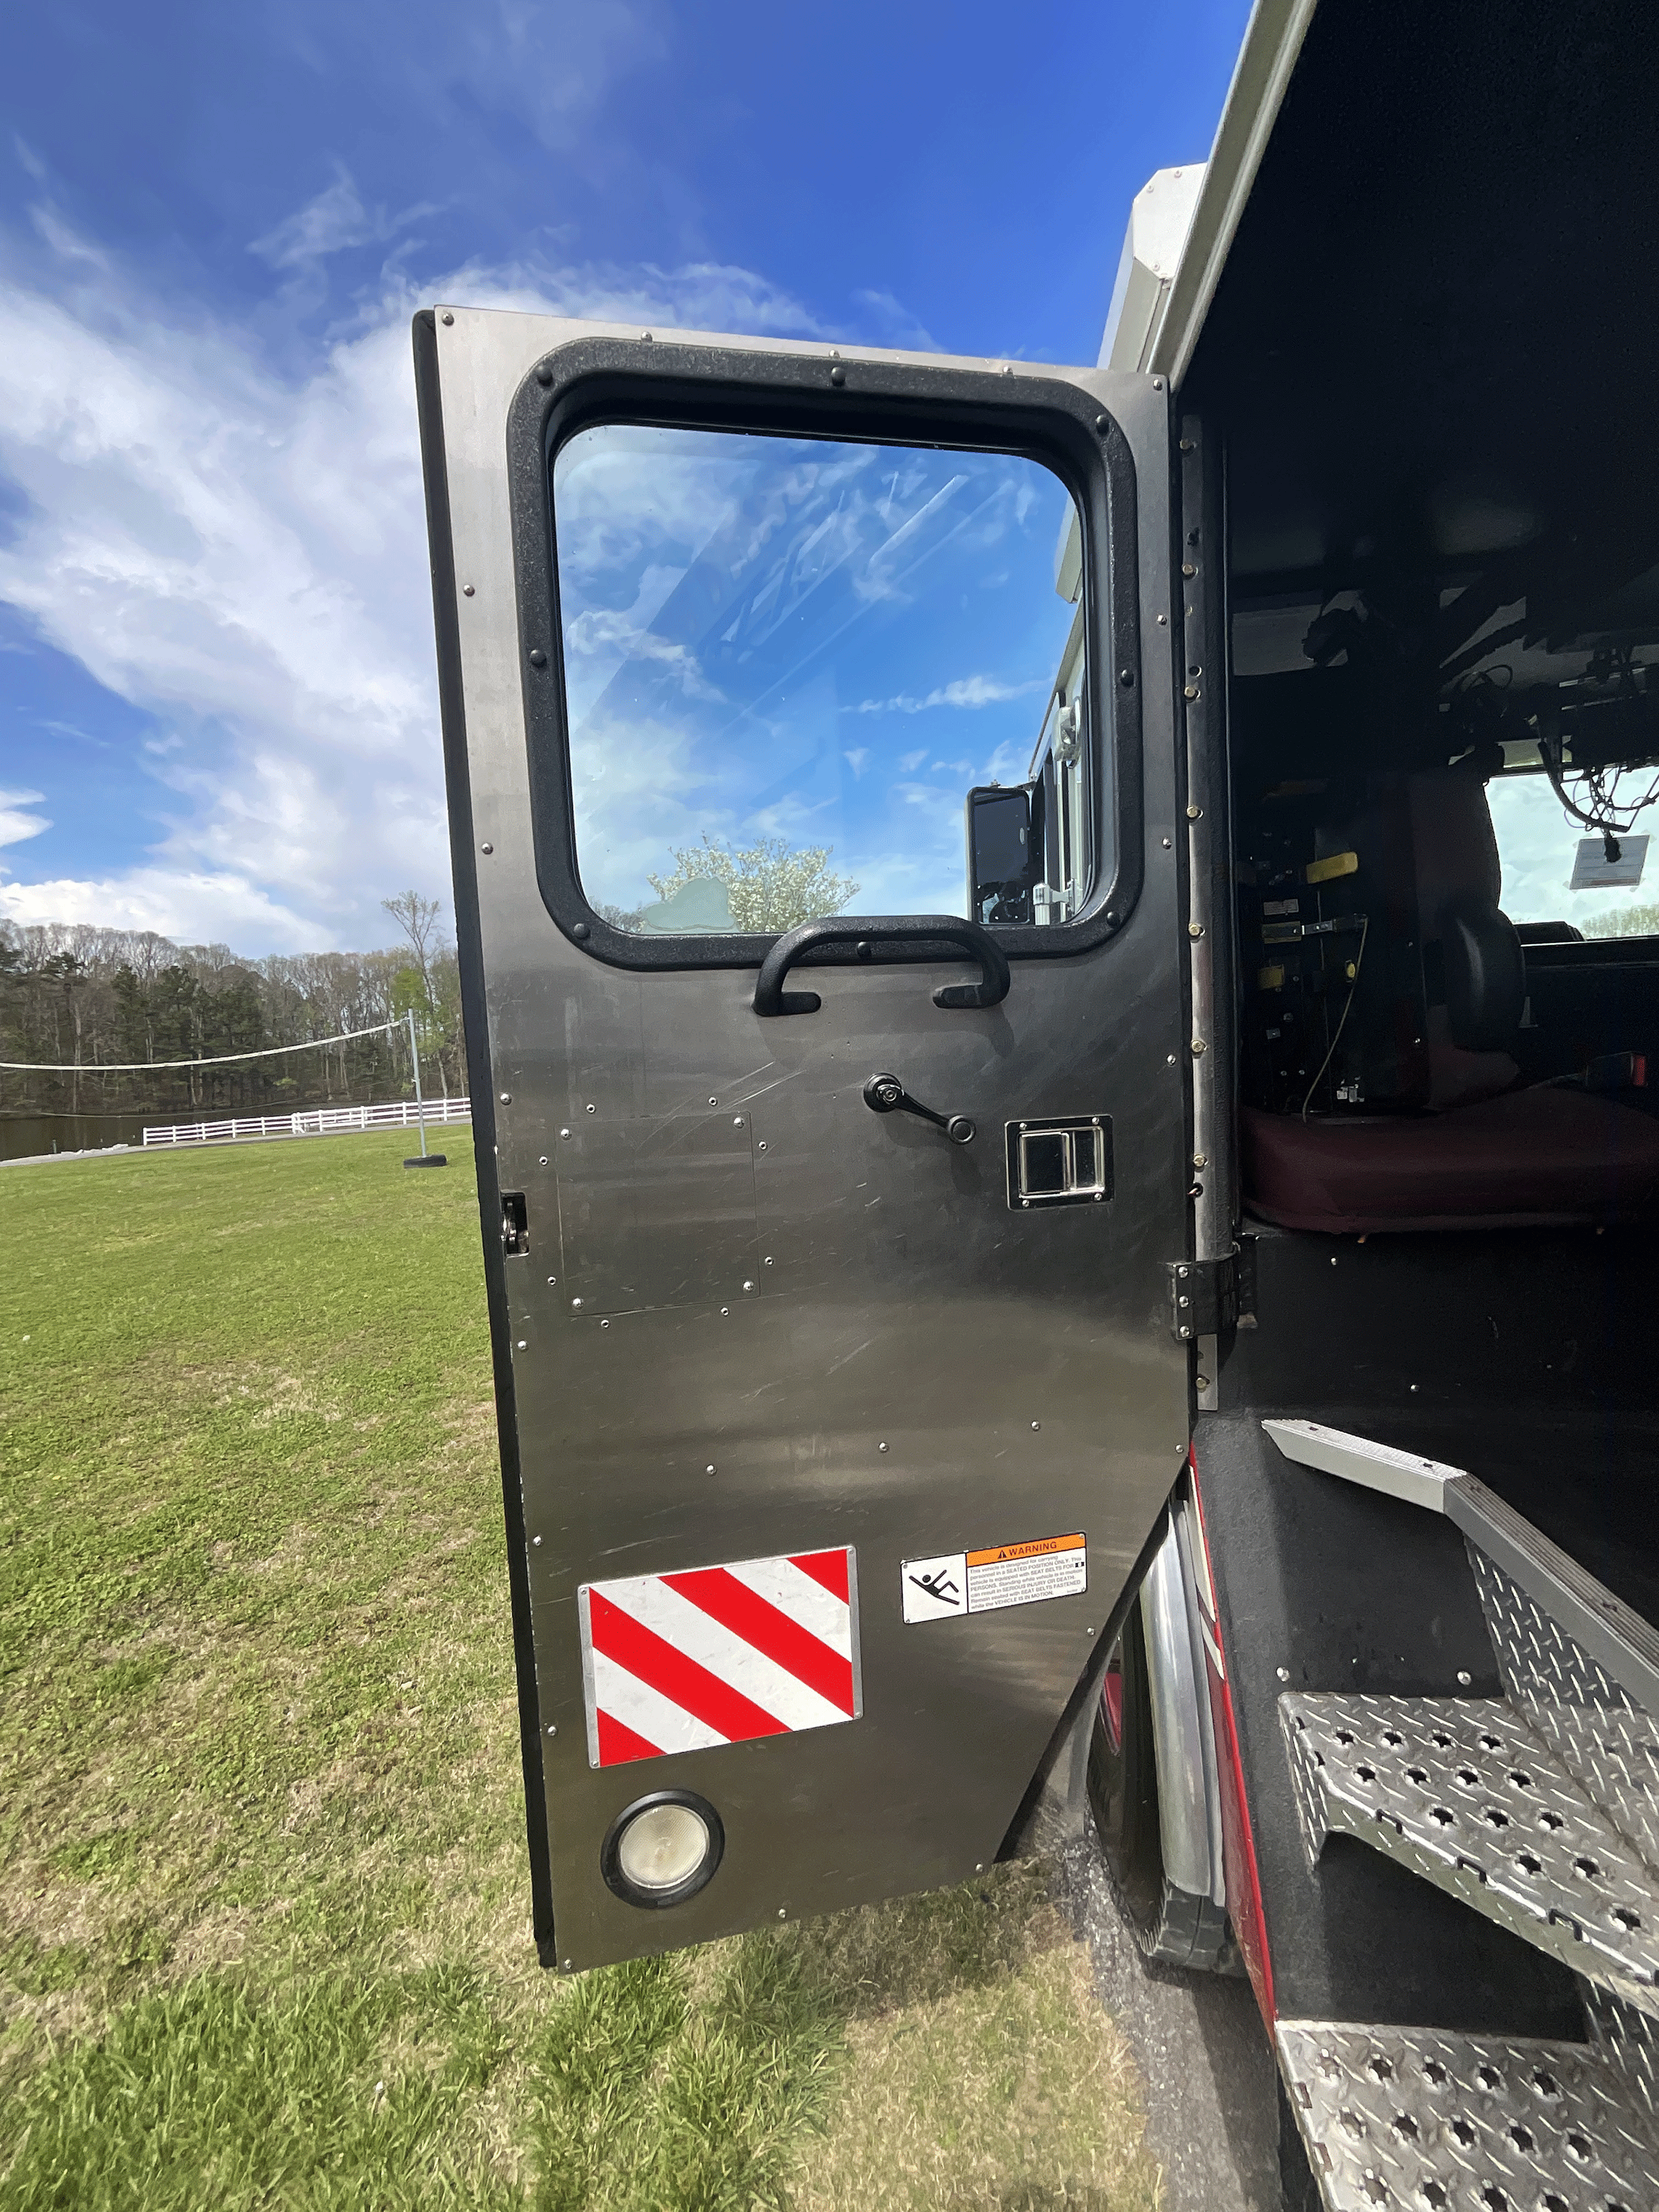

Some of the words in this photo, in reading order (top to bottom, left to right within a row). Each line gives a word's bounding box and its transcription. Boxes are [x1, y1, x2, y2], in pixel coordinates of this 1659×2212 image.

[1009, 1541, 1056, 1556] WARNING
[1006, 1560, 1029, 1568] designed
[971, 1571, 995, 1581] personnel
[1029, 1562, 1053, 1570] POSITION
[995, 1574, 1018, 1582] equipped
[999, 1579, 1021, 1587] Standing
[991, 1592, 1009, 1600] seated
[1053, 1580, 1080, 1588] FASTENED
[1002, 1584, 1026, 1592] SERIOUS
[995, 1597, 1017, 1605] VEHICLE
